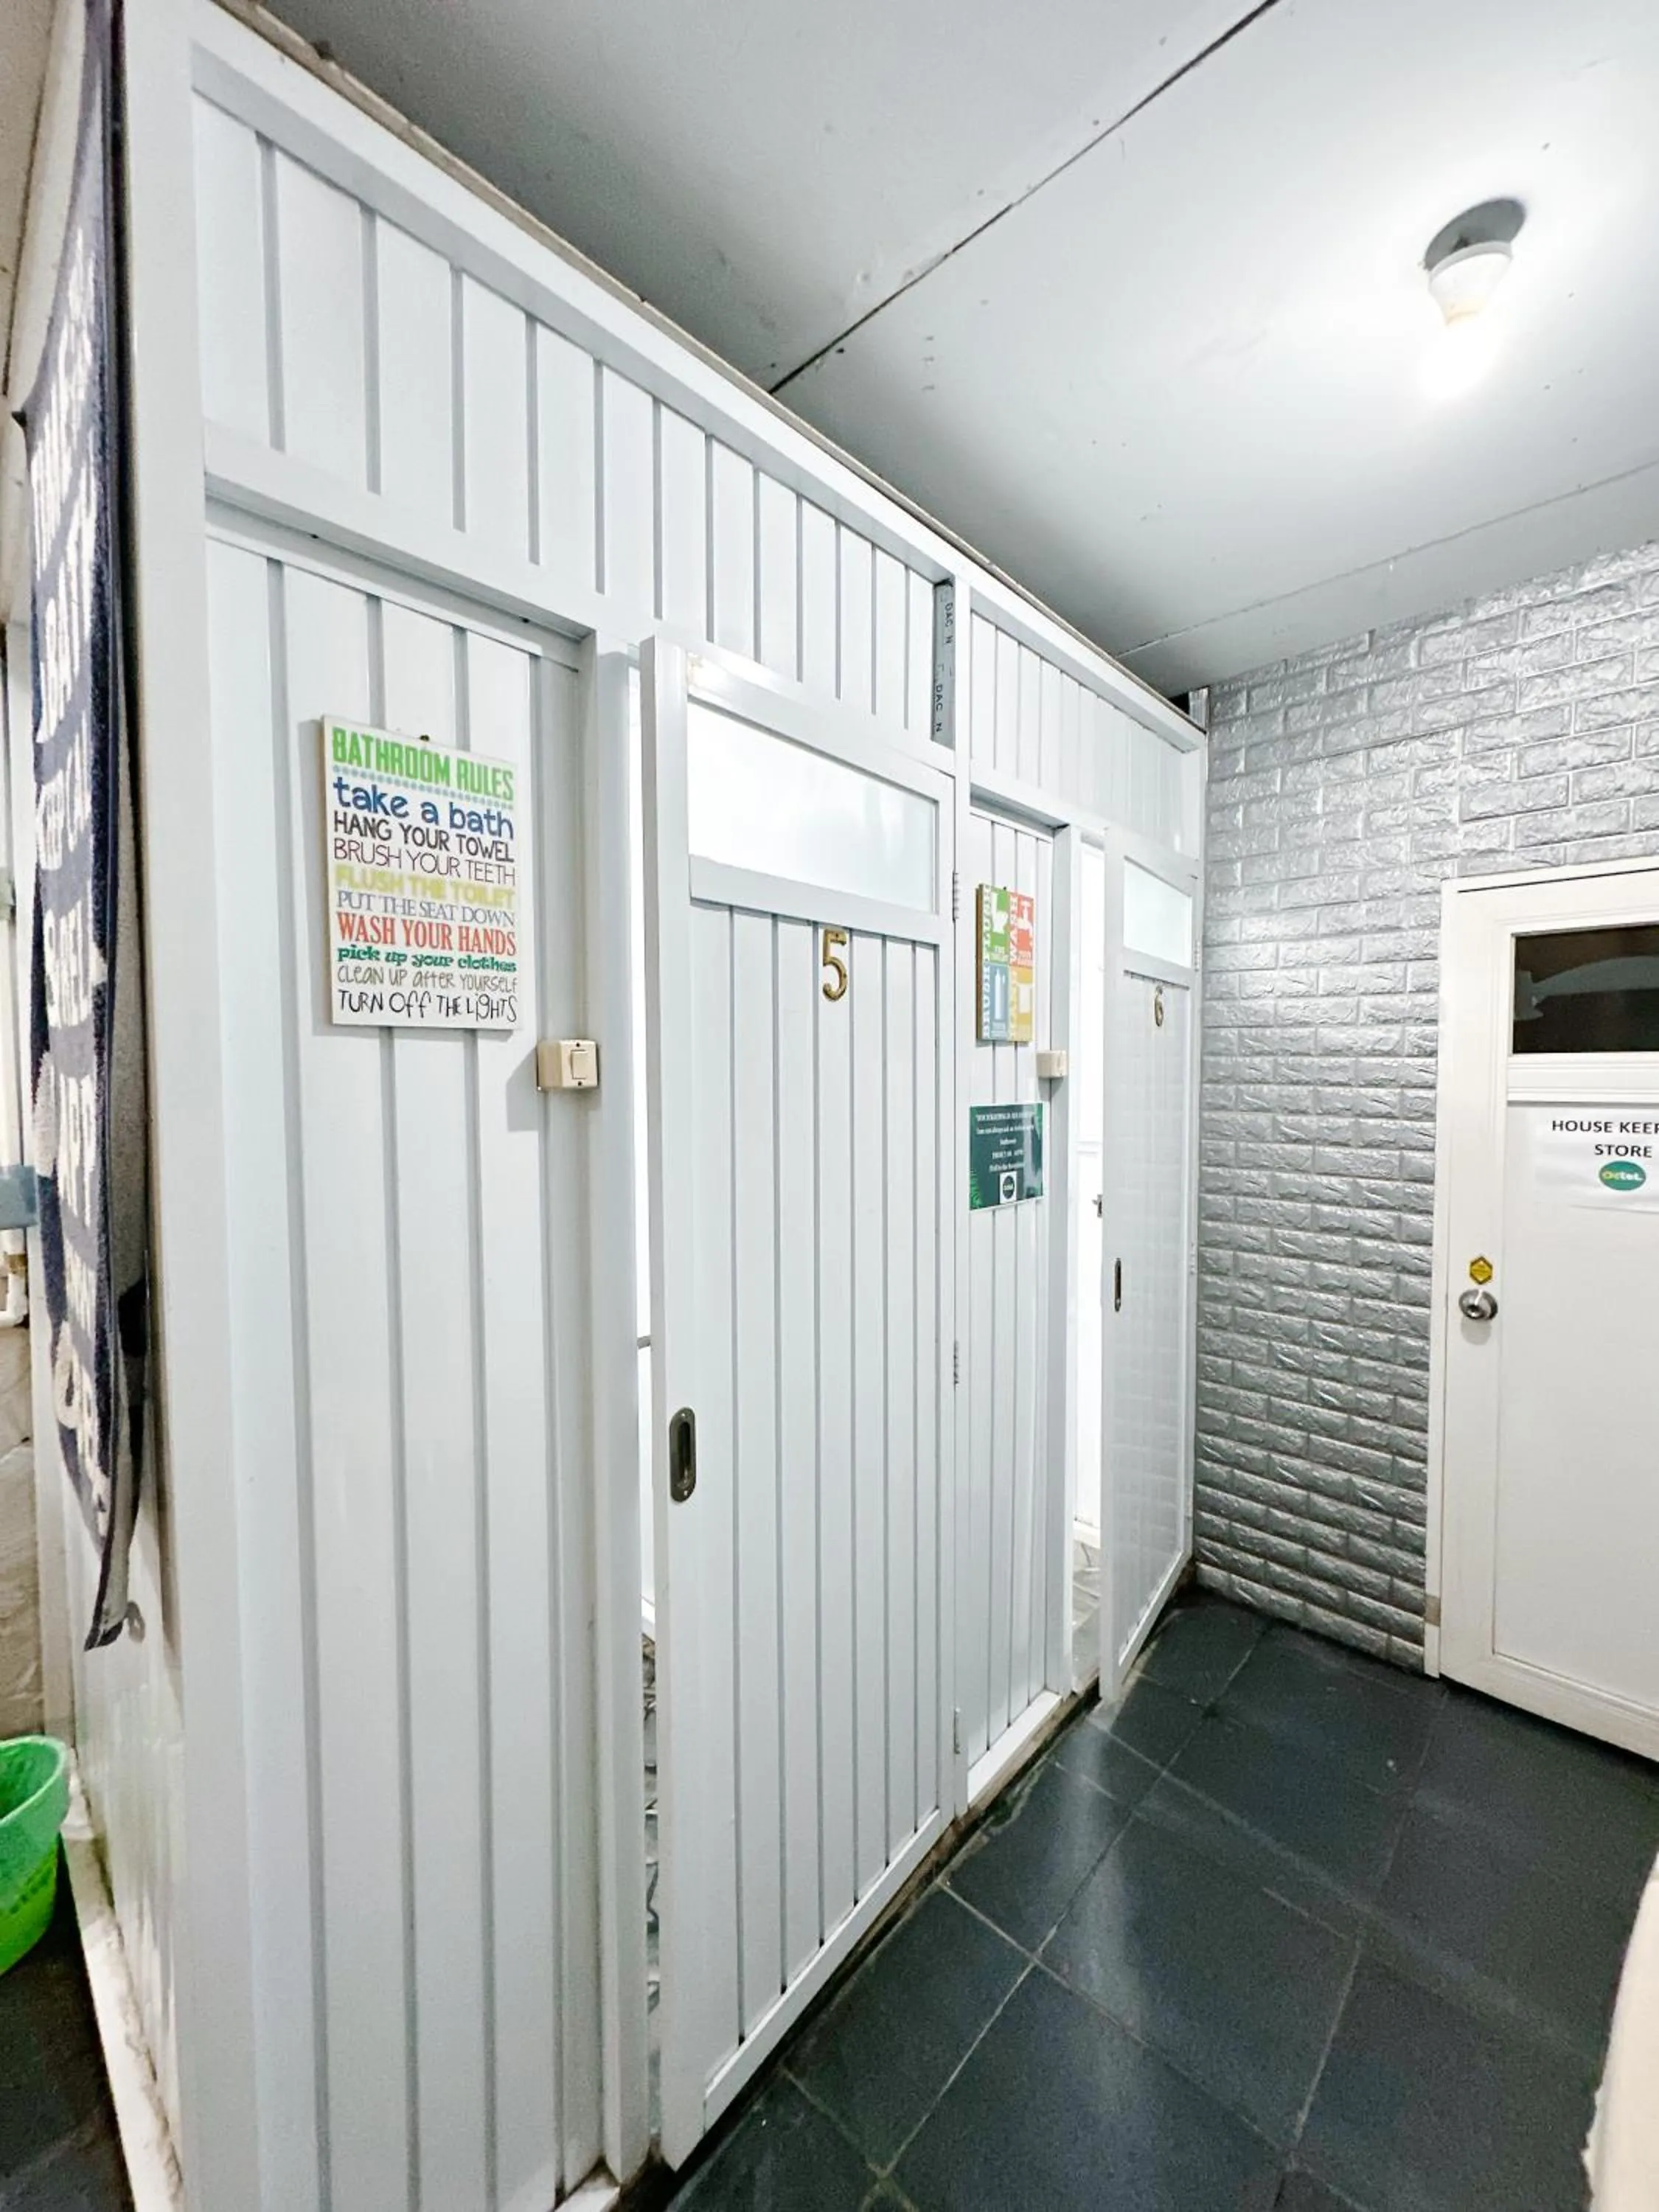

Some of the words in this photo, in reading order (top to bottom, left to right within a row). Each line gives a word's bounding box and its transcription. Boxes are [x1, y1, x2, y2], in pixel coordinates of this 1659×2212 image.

[332, 726, 450, 787] BATHROOM
[457, 757, 514, 801] RULES
[333, 777, 408, 818] take
[420, 801, 439, 826] a
[449, 801, 514, 839] bath
[334, 810, 392, 841] HANG
[400, 822, 450, 852] YOUR
[456, 834, 515, 862] TOWEL
[334, 838, 402, 869] BRUSH
[406, 850, 461, 877] YOUR
[465, 859, 515, 886] TEETH
[336, 864, 403, 897] FLUSH
[408, 874, 446, 900] THE
[451, 881, 515, 908] TOILET
[338, 890, 376, 911] PUT
[378, 894, 417, 914] THE
[419, 900, 459, 920] SEAT
[462, 907, 515, 927] DOWN
[336, 911, 396, 945] WASH
[401, 918, 453, 951] YOUR
[458, 925, 516, 956] HANDS
[337, 945, 380, 962] pick
[385, 952, 407, 966] up
[411, 953, 454, 967] your
[458, 955, 517, 972] clothes
[389, 969, 407, 986] UP
[822, 928, 847, 1001] 5
[338, 989, 384, 1013] TURN
[437, 995, 463, 1018] THE
[1154, 985, 1164, 1026] 6
[1552, 1120, 1613, 1133] HOUSE
[1595, 1144, 1652, 1158] STORE
